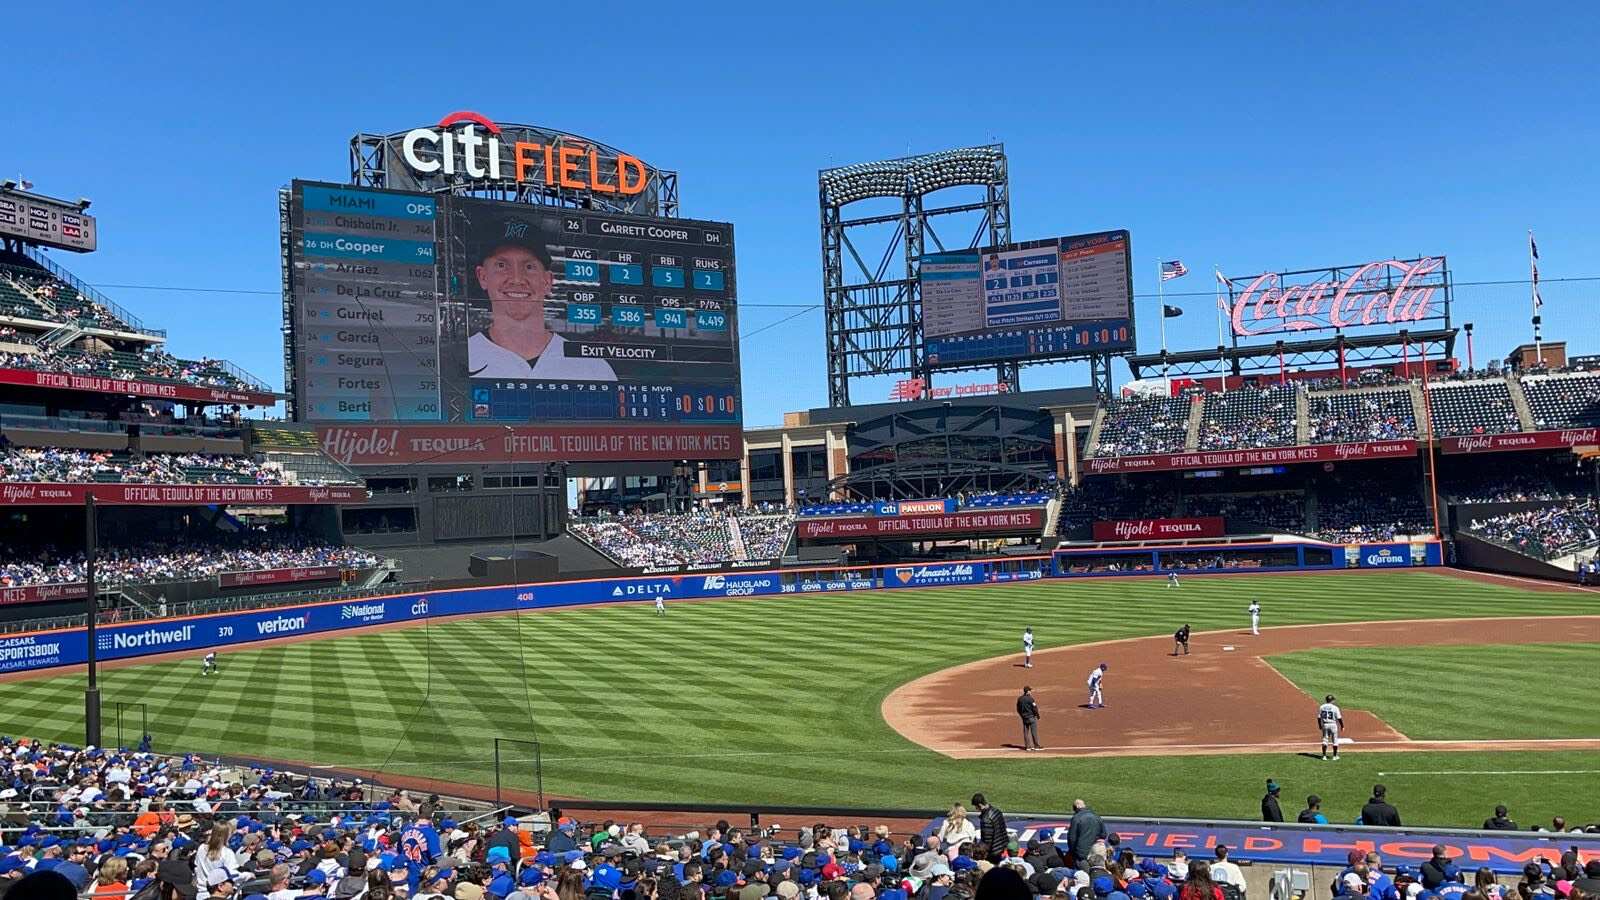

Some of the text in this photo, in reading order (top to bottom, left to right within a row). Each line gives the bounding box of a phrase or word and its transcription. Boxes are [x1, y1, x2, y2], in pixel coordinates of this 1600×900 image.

[514, 141, 647, 195] FIELD
[329, 195, 432, 215] MIAMI OPS
[30, 208, 48, 217] HOU
[31, 220, 47, 229] MIN
[63, 215, 80, 225] TOR
[335, 216, 385, 230] Chisholm
[387, 220, 399, 232] Jr.
[63, 228, 80, 236] LAA
[567, 220, 719, 243] 26 GARRETT COOPER DH
[306, 240, 317, 248] 26
[335, 238, 384, 254] Cooper
[415, 248, 432, 257] .941
[572, 249, 592, 259] AVG
[618, 253, 632, 262] HR
[660, 256, 675, 265] RBI
[695, 260, 719, 269] RUNS
[572, 265, 593, 276] .310
[337, 284, 401, 299] De La Cruz
[574, 292, 594, 302] OBP
[1231, 256, 1446, 336] Coca-Cola
[619, 295, 637, 304] SLG
[661, 298, 680, 308] OPS
[700, 300, 720, 310] P/PA
[337, 308, 383, 321] Gurriel
[574, 309, 596, 320] .355
[617, 311, 640, 322] .586
[662, 313, 682, 324] .941
[699, 316, 724, 327] 4.419
[581, 345, 656, 358] EXIT VELOCITY
[337, 354, 383, 368] Segura
[36, 373, 69, 386] OFFICIAL
[71, 376, 101, 390] TEQUILA
[101, 379, 110, 390] OF
[112, 380, 126, 392] THE
[127, 382, 140, 393] NEW
[141, 383, 158, 395] YORK
[159, 385, 176, 396] METS
[338, 378, 381, 390] Fortes
[339, 401, 371, 413] Berti
[321, 428, 730, 463] Hijole! TEQUILA OFFICIAL TEQUILA OF THE NEW YORK METS
[1458, 436, 1492, 452] Hijole!
[1560, 429, 1597, 446] Hijole!
[1171, 455, 1202, 467] OFFICIAL
[1204, 453, 1234, 465] TEQUILA
[1235, 453, 1244, 463] OF
[1246, 452, 1260, 462] THE
[1261, 451, 1276, 461] NEW
[1278, 450, 1296, 460] YORK
[1298, 448, 1318, 459] METS
[1335, 443, 1368, 459] Hijole!
[3, 485, 36, 503] Hijole!
[124, 487, 160, 500] OFFICIAL
[162, 487, 194, 500] TEQUILA
[194, 487, 204, 500] OF
[207, 488, 221, 500] THE
[222, 488, 236, 500] NEW
[237, 488, 254, 500] YORK
[255, 488, 273, 500] METS
[901, 503, 941, 513] PAVILION
[807, 513, 1031, 536] Hijole! TEQUILA OFFICIAL TEQUILA OF THE NEW YORK METS
[1115, 521, 1201, 540] Hijole! TEQUILA
[1367, 554, 1404, 565] Corona
[915, 564, 973, 578] Amazin' Mets
[1029, 570, 1042, 580] 370
[726, 579, 770, 590] HAUGLAND
[915, 576, 973, 584] FOUNDATION
[3, 588, 26, 601] METS
[64, 586, 88, 594] TEQUIL
[627, 584, 671, 594] DELTA
[726, 588, 755, 597] GROUP
[781, 584, 796, 593] 380
[516, 592, 534, 601] 408
[351, 603, 385, 617] National
[257, 616, 305, 635] verizon
[114, 625, 192, 649] Northwell
[218, 626, 233, 637] 370
[0, 637, 35, 647] CAESARS
[0, 643, 60, 660] SPORTSBOOK
[27, 657, 60, 667] REWARDS
[1115, 831, 1600, 868] FIELD HOM
